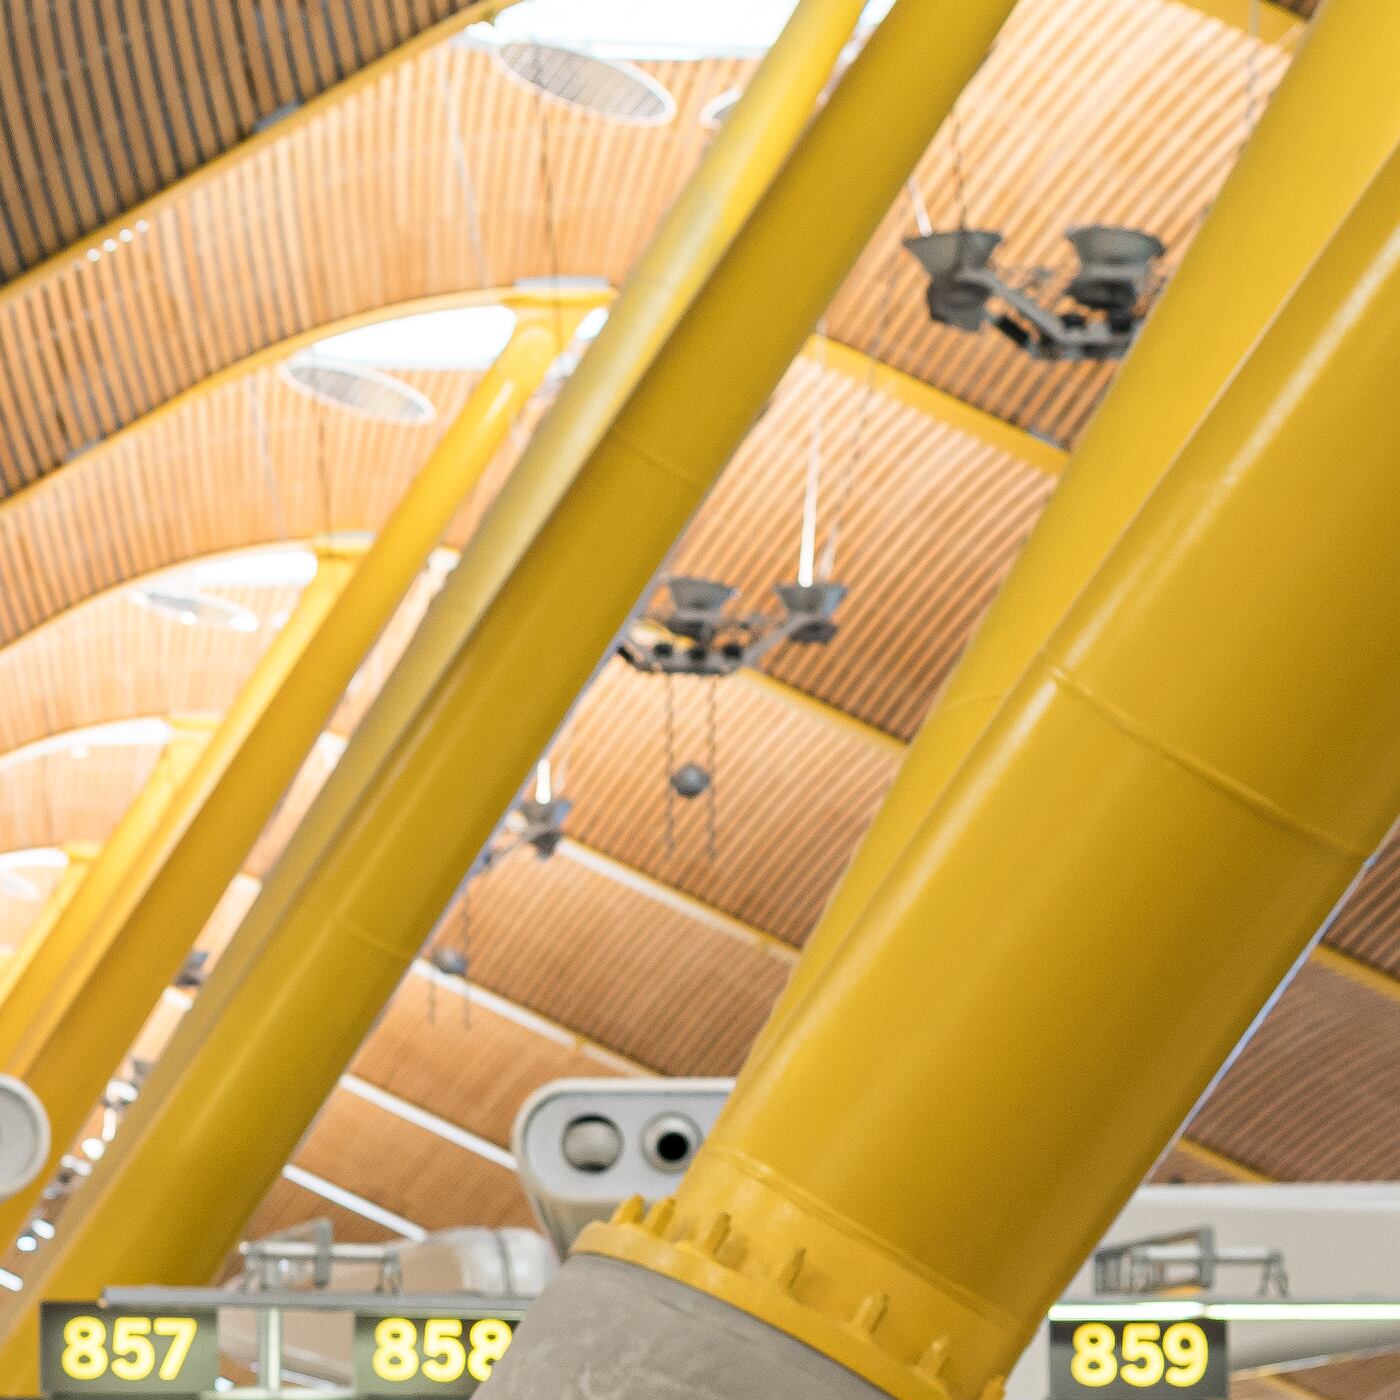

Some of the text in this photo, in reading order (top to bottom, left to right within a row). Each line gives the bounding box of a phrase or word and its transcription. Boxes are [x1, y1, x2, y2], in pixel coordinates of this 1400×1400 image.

[61, 1316, 198, 1381] 857
[371, 1317, 513, 1383] 858
[1070, 1322, 1209, 1388] 859
